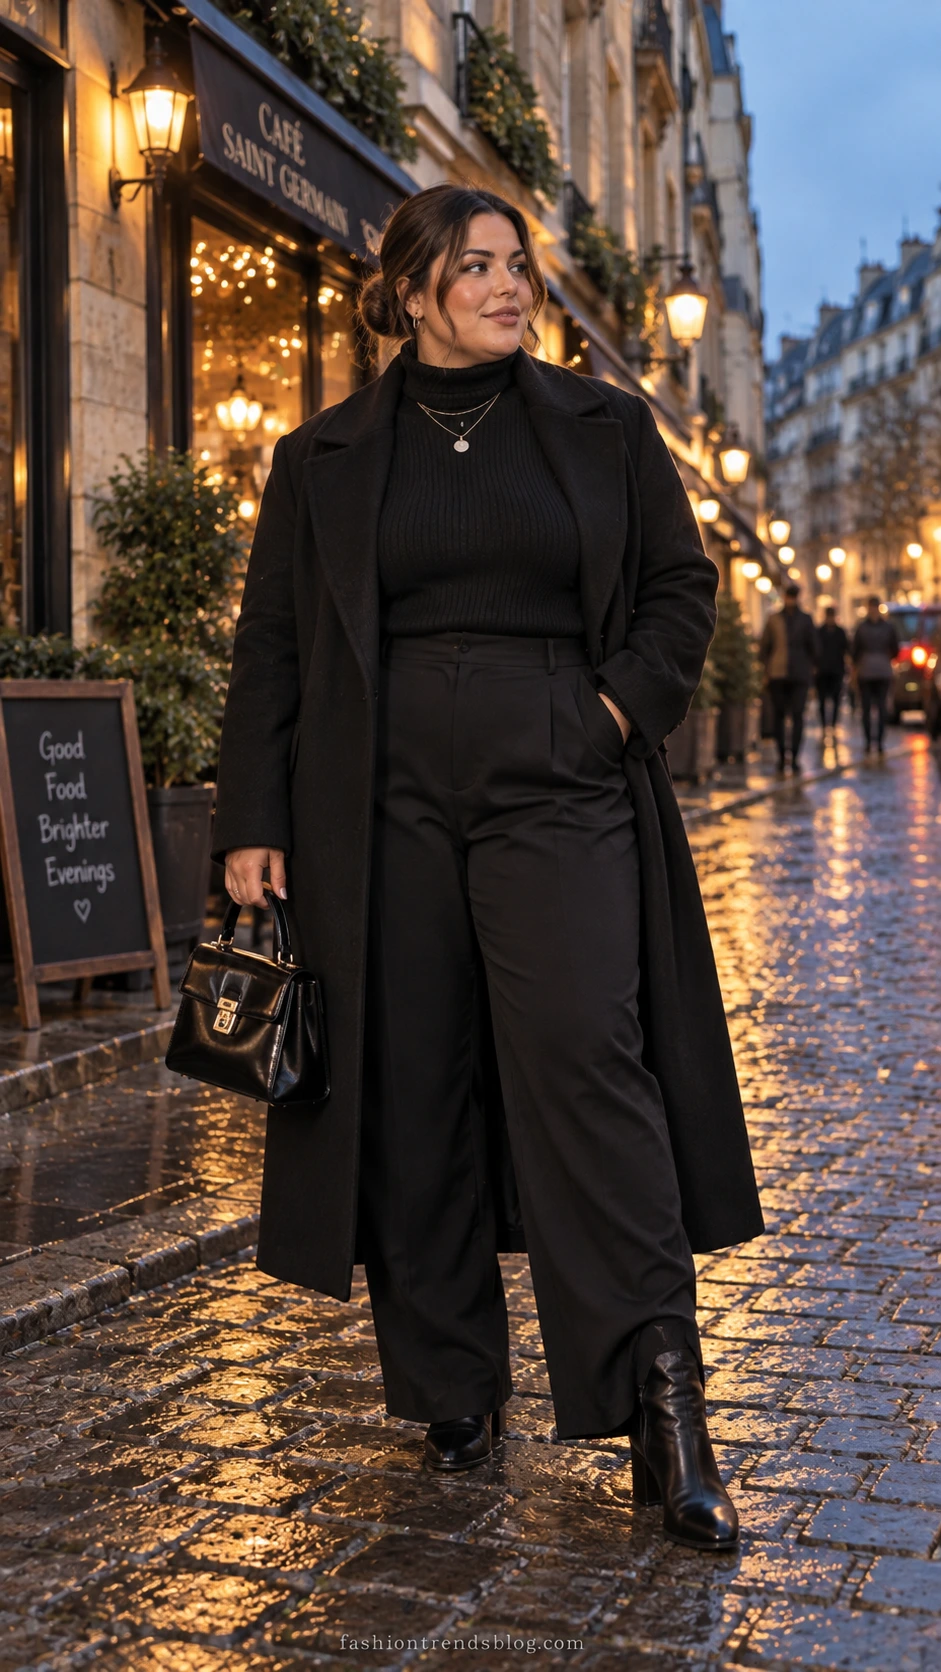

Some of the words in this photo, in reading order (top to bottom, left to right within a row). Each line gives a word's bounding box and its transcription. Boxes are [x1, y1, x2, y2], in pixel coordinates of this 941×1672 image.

[258, 102, 305, 167] CAFÉ
[222, 122, 276, 187] SAINT
[280, 164, 350, 238] GERMAIN
[39, 730, 85, 765] Good
[45, 772, 87, 801] Food
[38, 813, 109, 852] Brighter
[45, 856, 115, 893] Evenings
